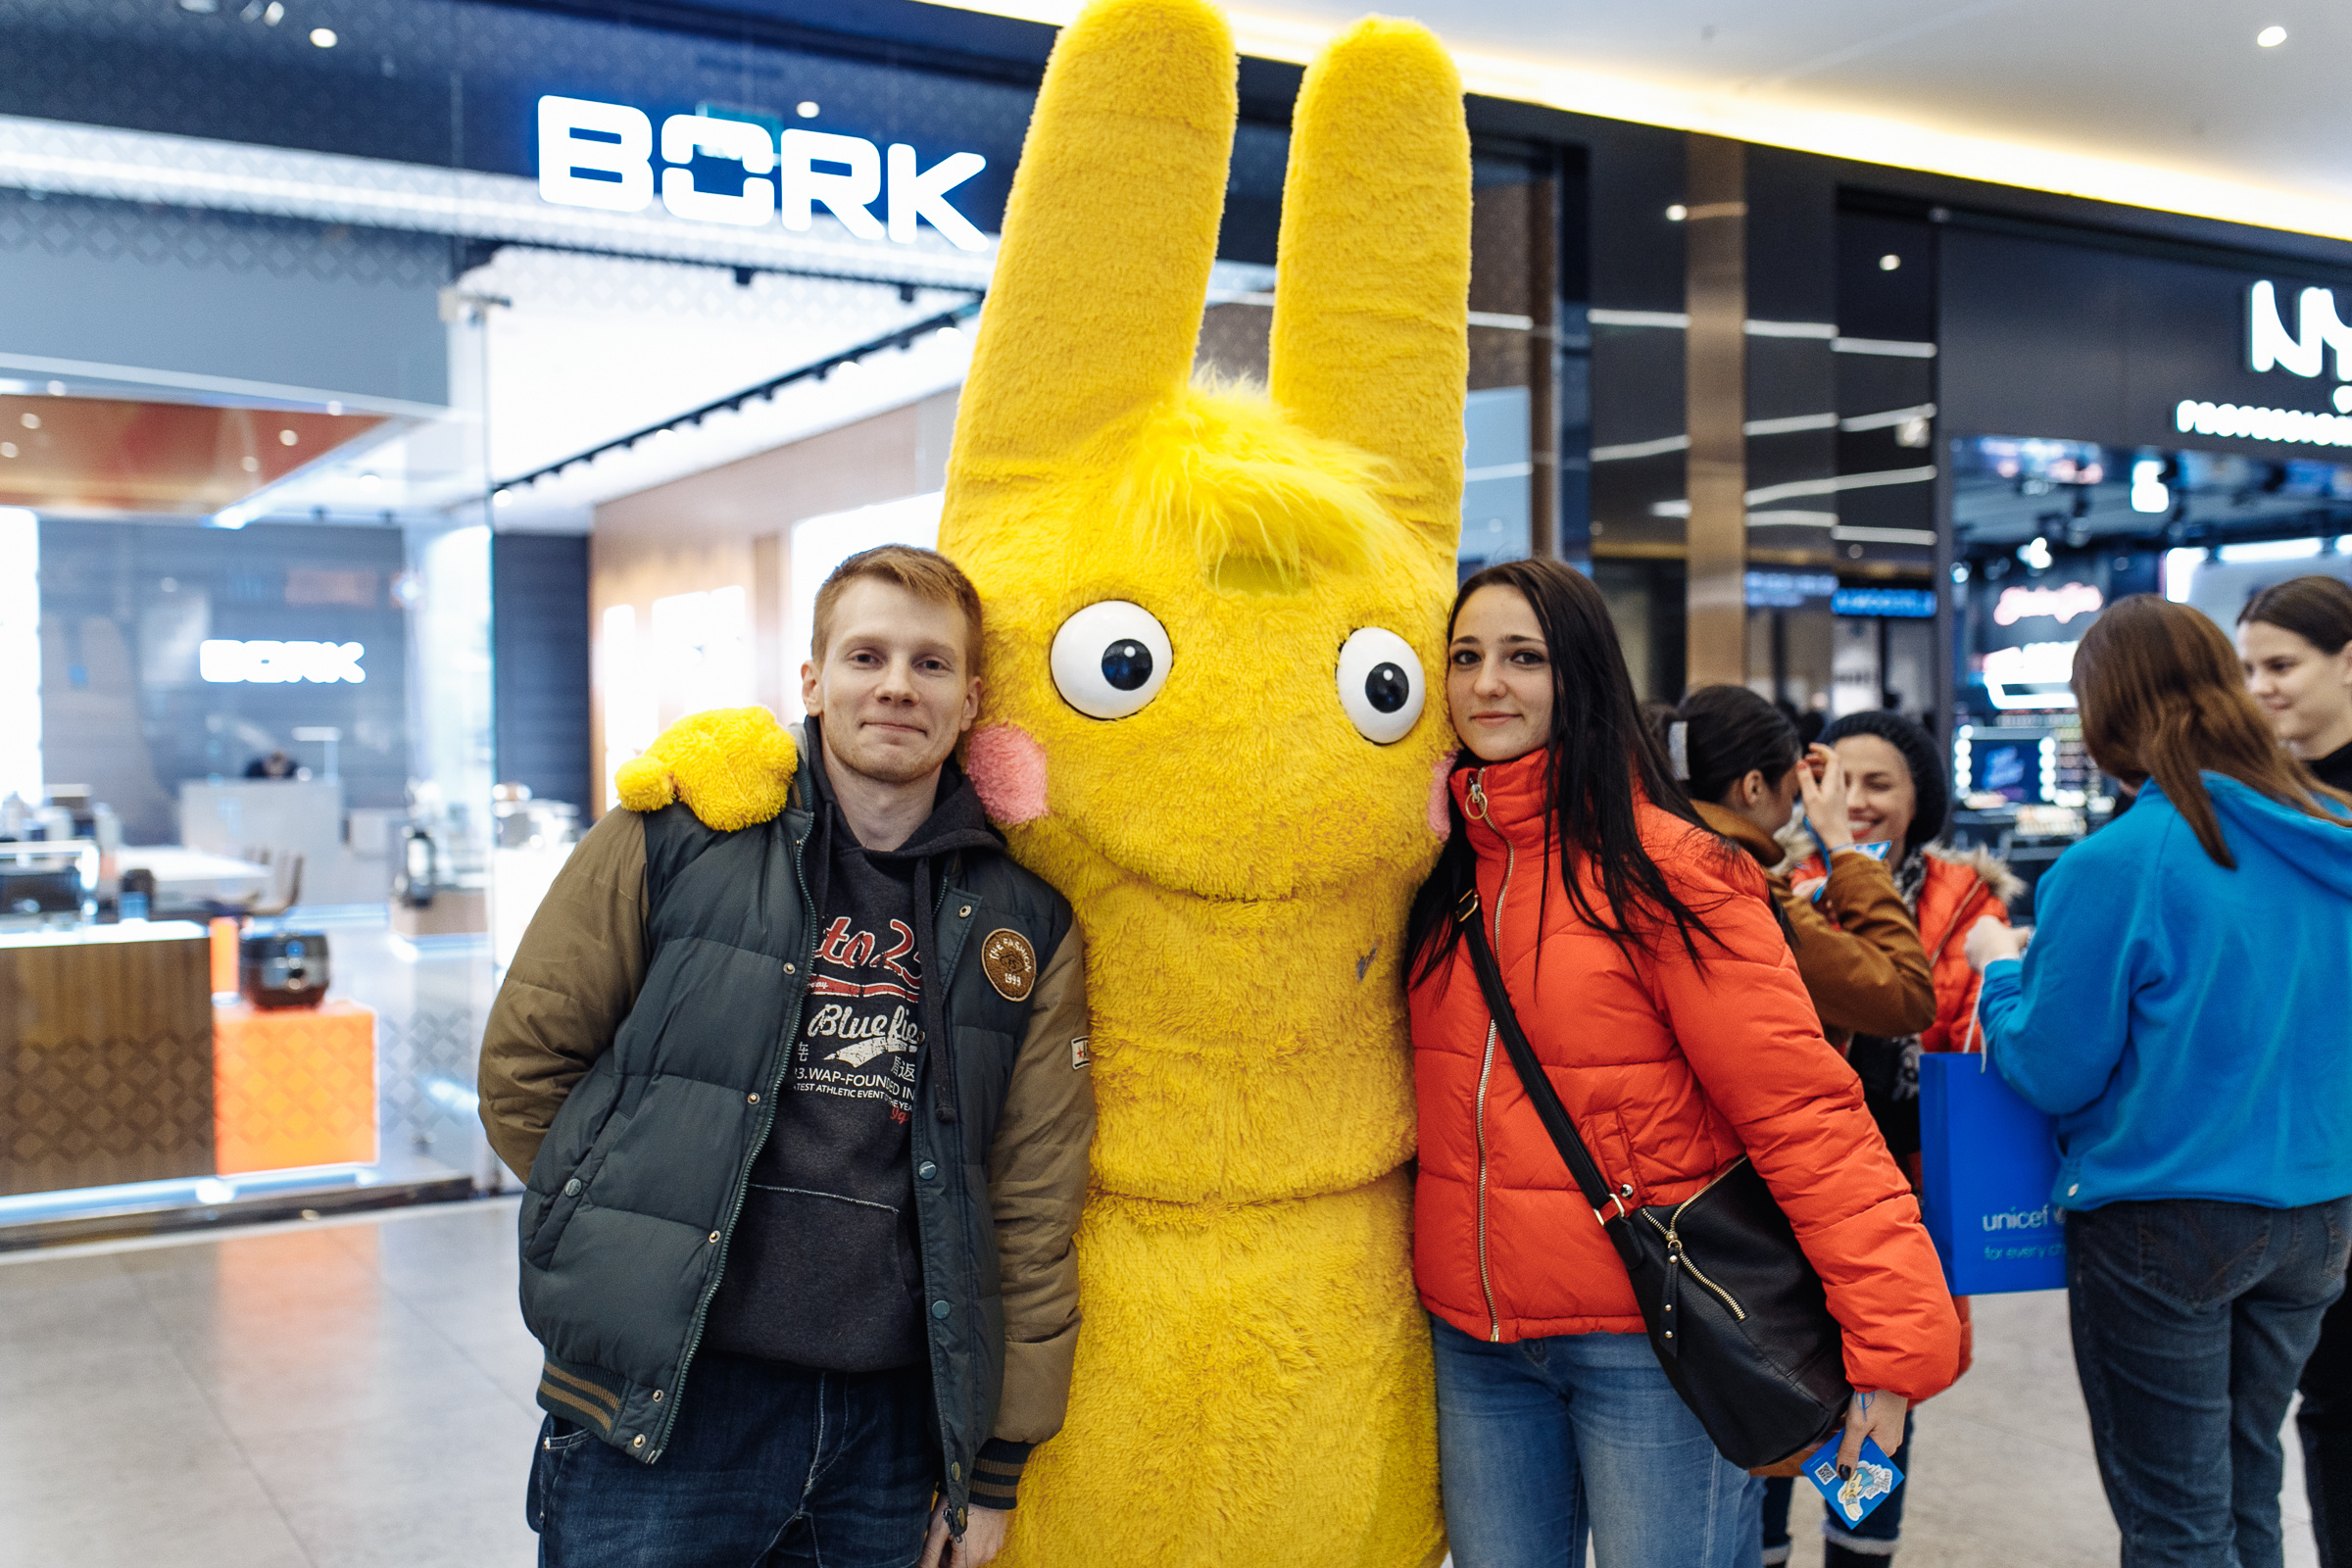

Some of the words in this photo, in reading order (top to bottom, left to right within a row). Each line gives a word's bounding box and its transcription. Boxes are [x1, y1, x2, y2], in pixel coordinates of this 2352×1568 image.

[537, 95, 990, 252] BORK
[815, 1084, 857, 1099] ATHLETIC
[857, 1089, 885, 1100] EVENT
[1982, 1203, 2049, 1233] unicef
